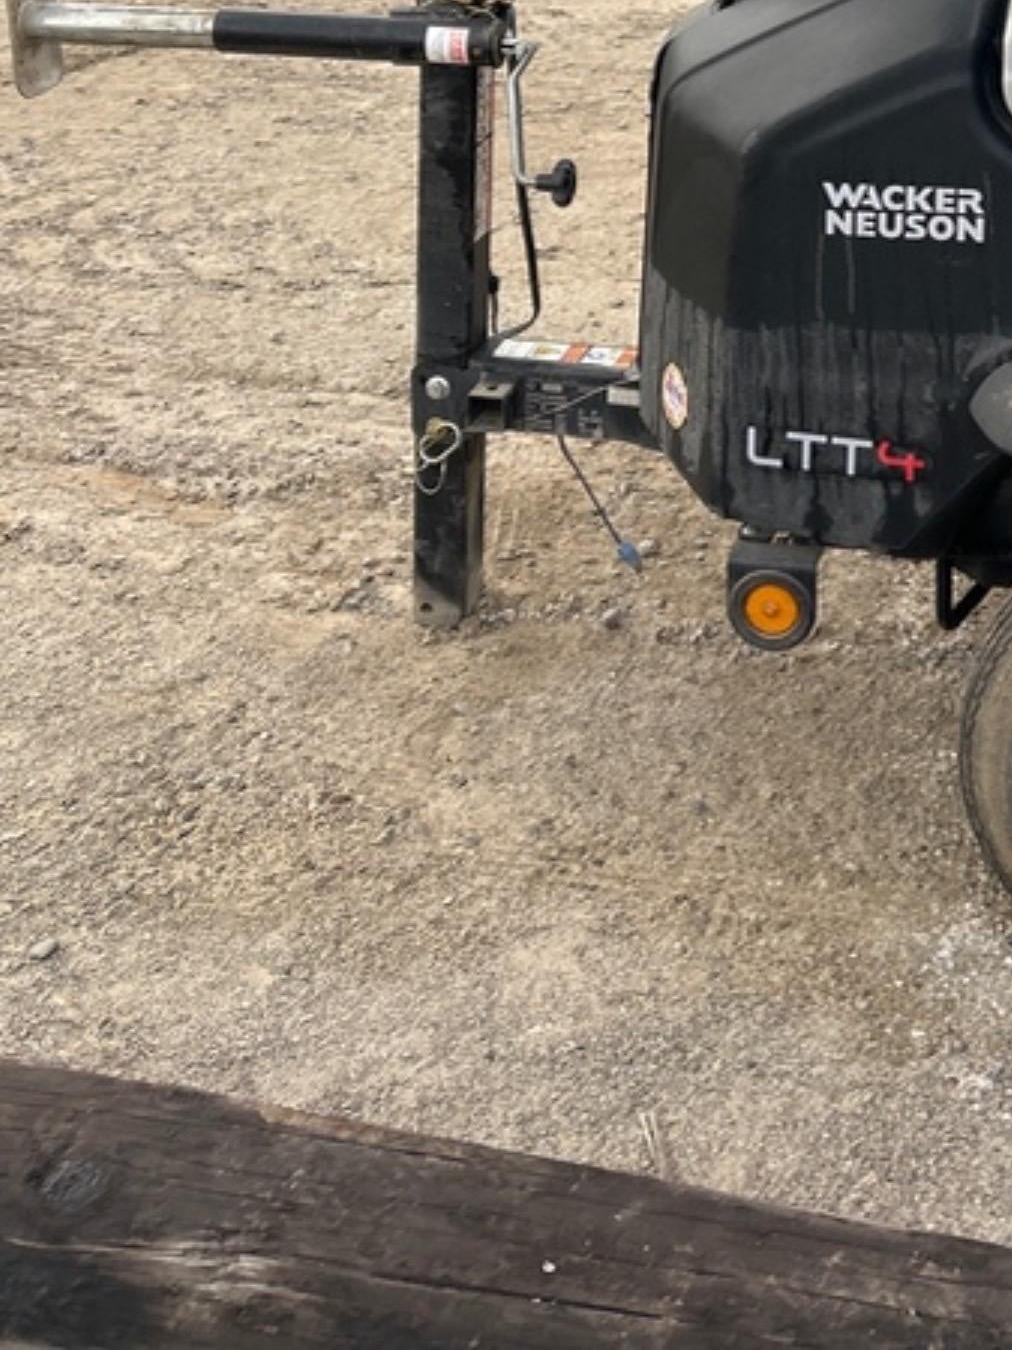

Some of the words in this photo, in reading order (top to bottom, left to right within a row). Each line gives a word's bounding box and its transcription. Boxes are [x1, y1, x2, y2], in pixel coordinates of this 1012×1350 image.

[821, 181, 985, 215] WACKER
[824, 208, 986, 244] NEUSON
[746, 425, 927, 484] LTT4
